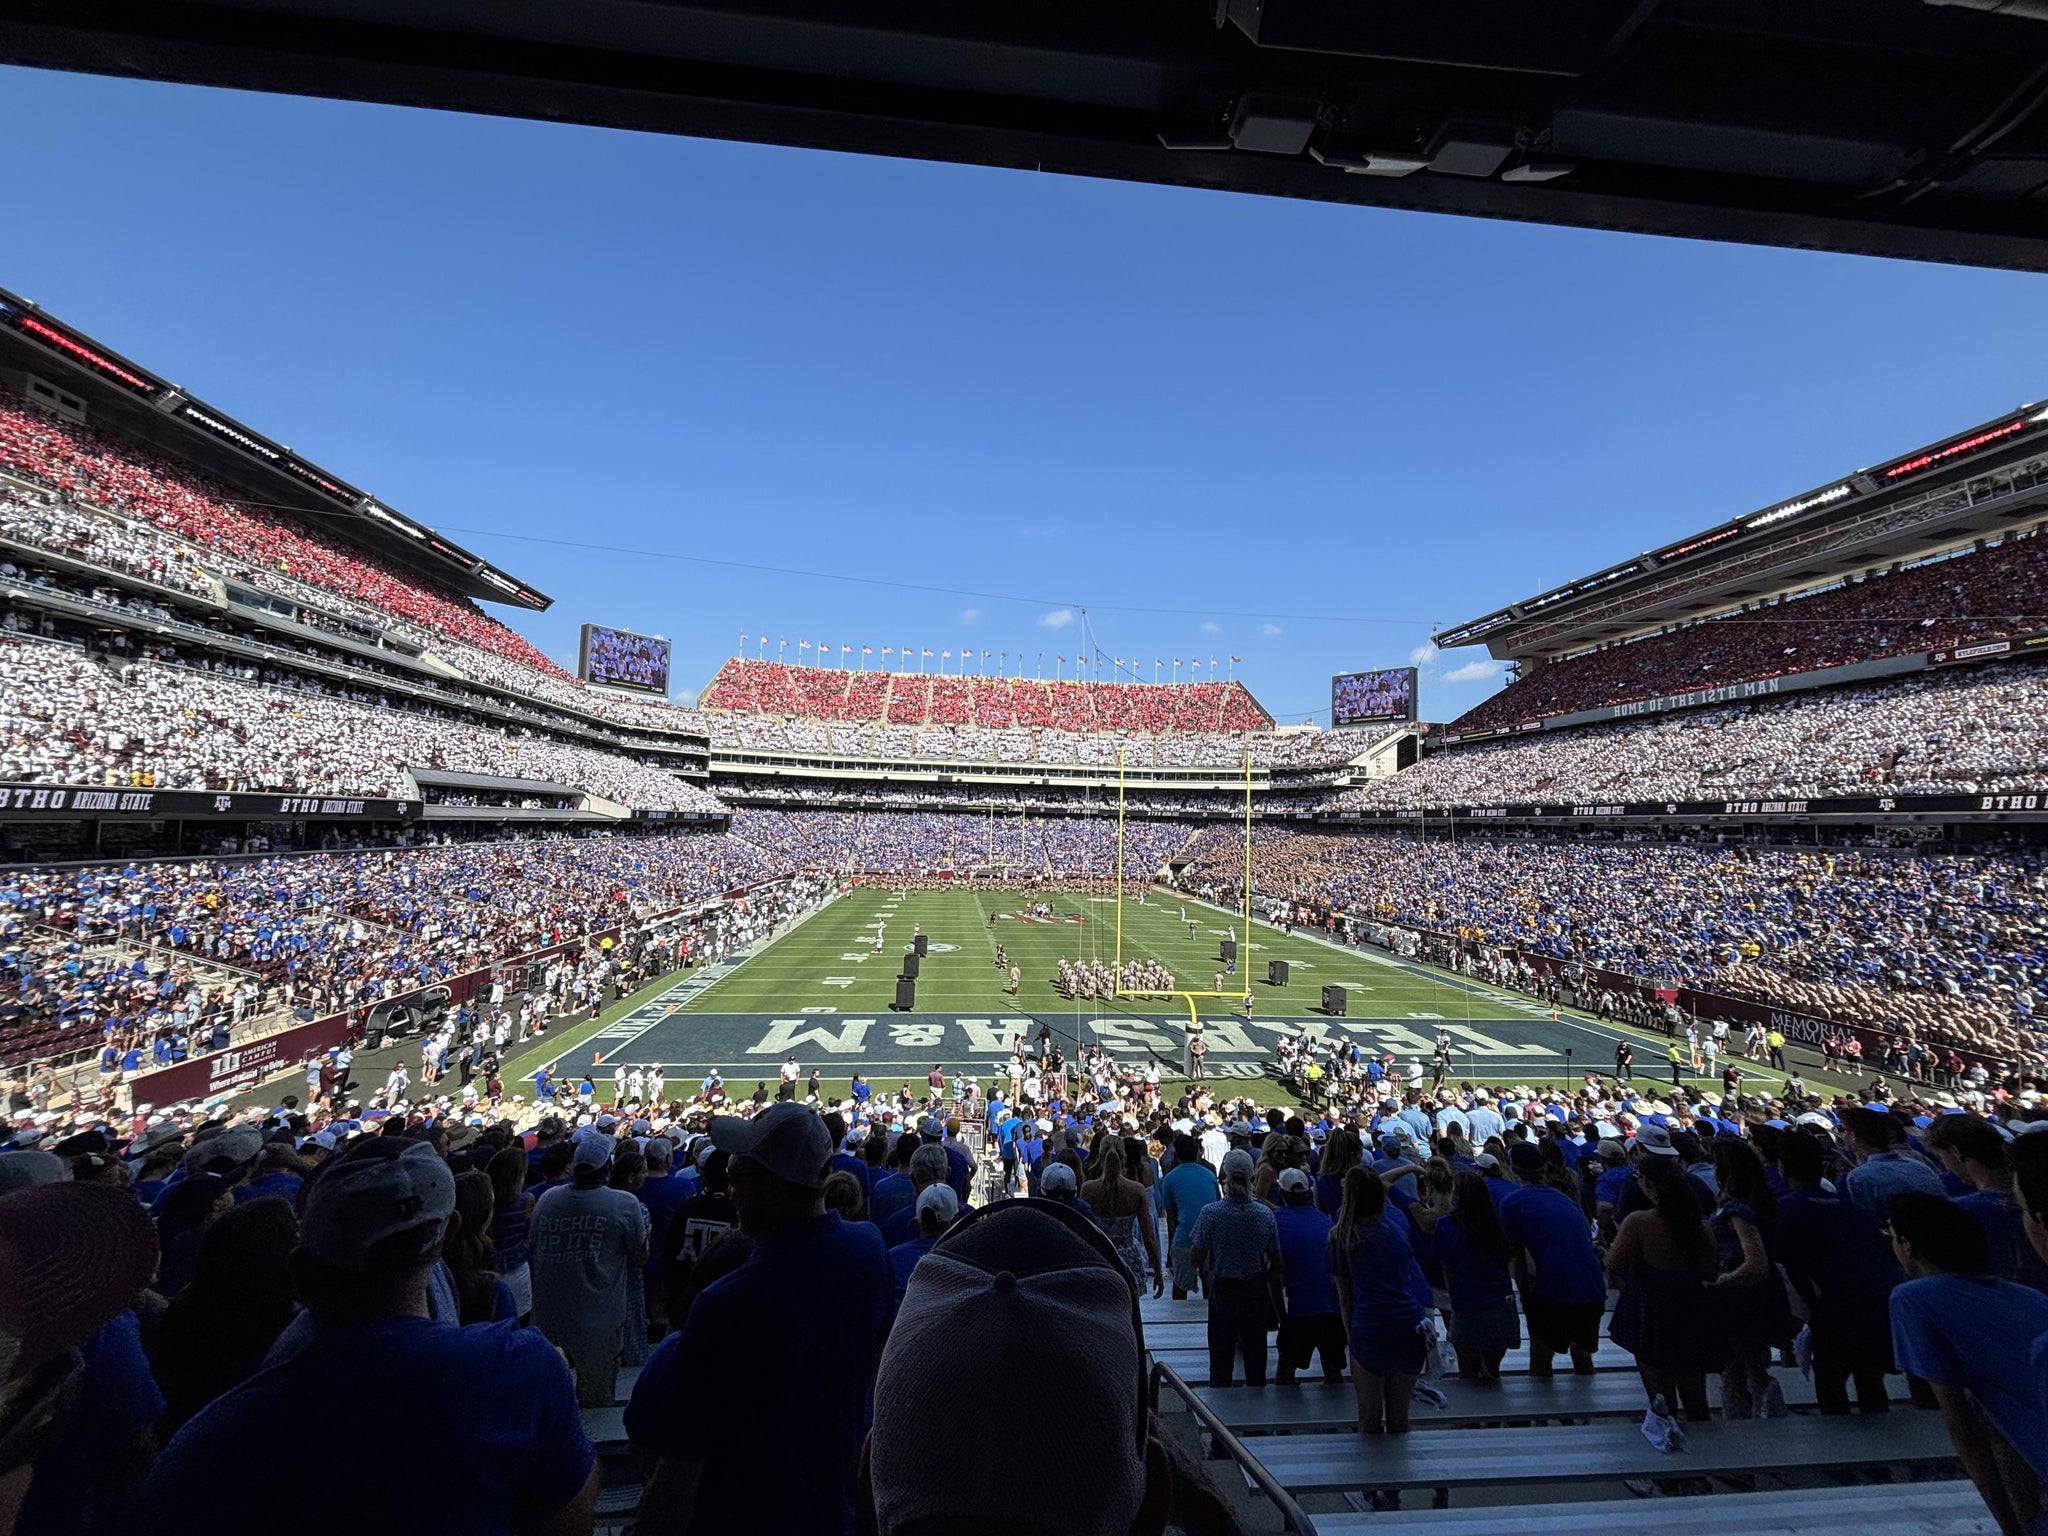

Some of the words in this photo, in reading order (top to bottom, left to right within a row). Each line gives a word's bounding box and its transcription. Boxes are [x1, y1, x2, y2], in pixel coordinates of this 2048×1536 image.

[1614, 703, 1645, 717] HOME
[1650, 698, 1664, 711] OF
[1670, 694, 1695, 708] THE
[1701, 687, 1737, 703] 12TH
[1744, 678, 1779, 696] MAN
[71, 791, 119, 810] ARIZONA
[120, 794, 153, 811] STATE
[280, 799, 318, 813] BTHO
[1725, 803, 1757, 813] BTHO
[1787, 801, 1808, 812] STATE
[1981, 795, 2037, 809] BTHO
[745, 1019, 1035, 1053] A&M
[242, 1048, 277, 1063] CAMPUS
[243, 1041, 277, 1056] AMERICAN
[209, 1079, 230, 1092] Where
